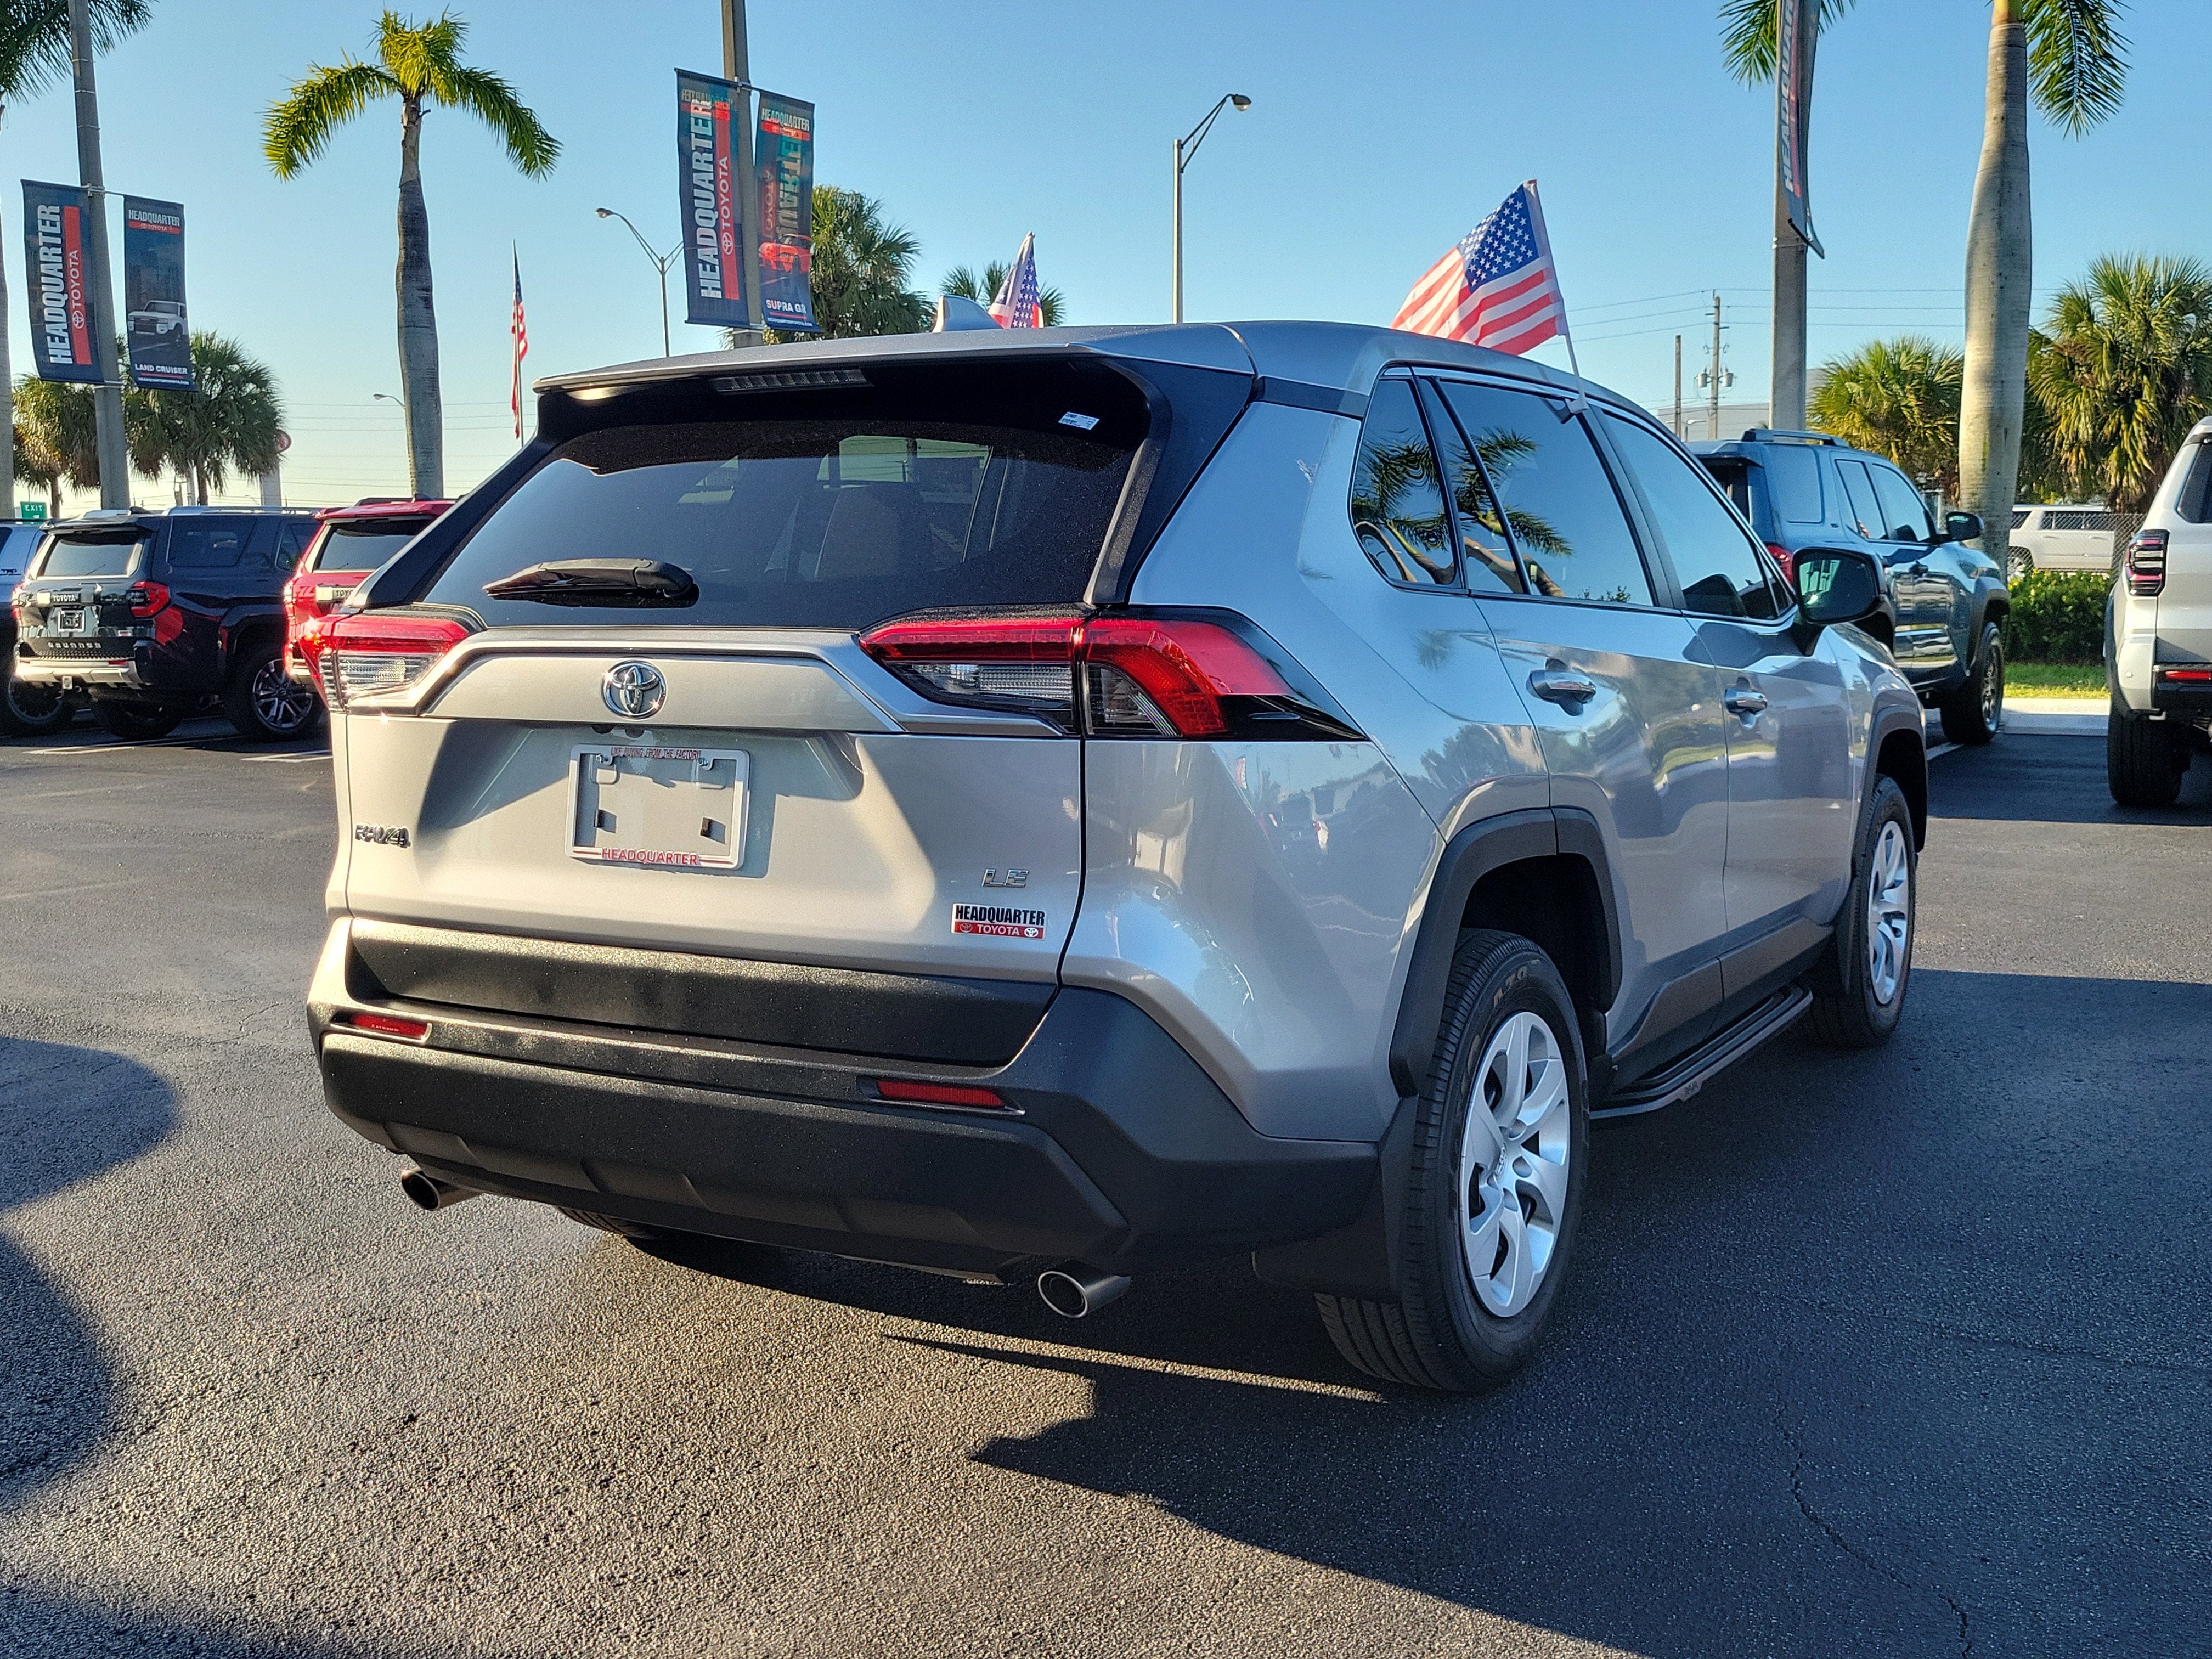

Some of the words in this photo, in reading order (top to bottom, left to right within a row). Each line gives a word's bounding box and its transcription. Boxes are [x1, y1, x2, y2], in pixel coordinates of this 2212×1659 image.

[761, 108, 810, 132] HEADQUARTER
[690, 99, 723, 298] HEADQUARTER
[719, 156, 731, 230] TOYOTA
[129, 210, 180, 227] HEADQUARTER
[38, 205, 74, 364] HEADQUARTER
[69, 250, 81, 308] TOYOTA
[766, 299, 794, 312] SUPRA
[795, 303, 806, 314] GR
[134, 363, 154, 371] LAND
[156, 366, 188, 374] CRUISER
[646, 748, 661, 758] FROM
[664, 749, 673, 759] THE
[602, 848, 698, 865] HEADQUARTER
[981, 868, 1030, 888] LE
[956, 905, 1045, 926] HEADQUARTER
[977, 924, 1020, 936] TOYOTA
